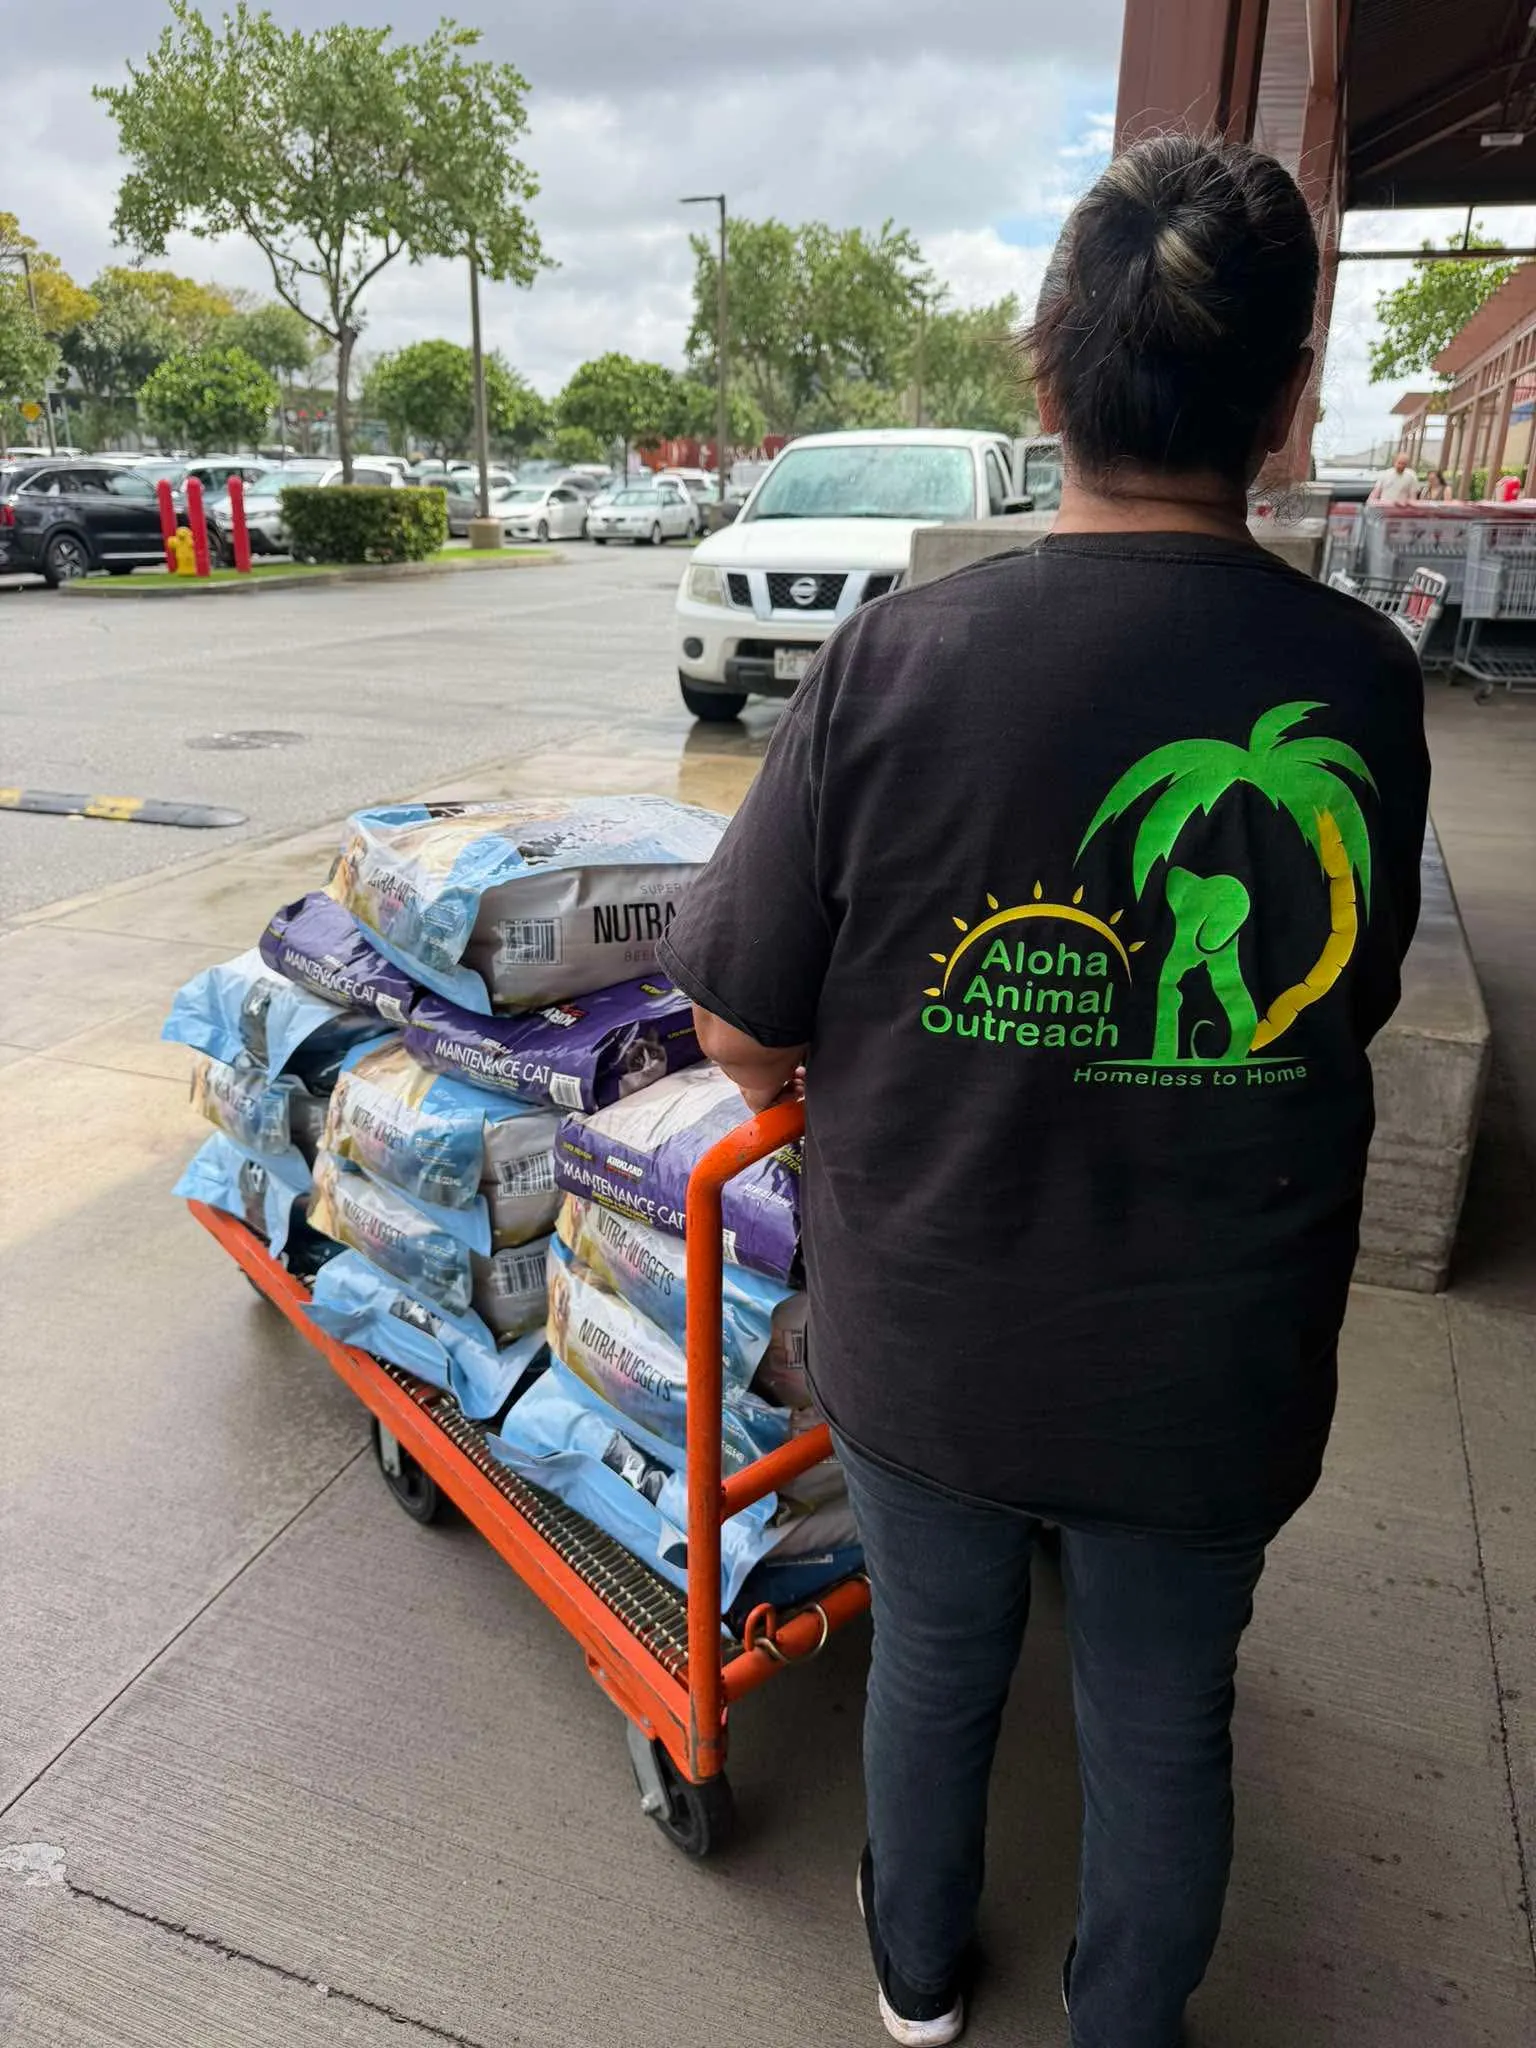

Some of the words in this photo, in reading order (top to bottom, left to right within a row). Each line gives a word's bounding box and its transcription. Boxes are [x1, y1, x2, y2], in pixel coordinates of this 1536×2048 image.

[640, 882, 682, 896] SUPER
[981, 938, 1108, 976] Aloha
[352, 980, 376, 1001] CAT
[963, 975, 1114, 1014] Animal
[921, 1004, 1119, 1047] Outreach
[435, 1039, 522, 1080] MAINTENANCE
[522, 1062, 551, 1085] CAT
[1073, 1067, 1202, 1086] Homeless
[1212, 1070, 1236, 1086] to
[1246, 1065, 1307, 1085] Home
[606, 1154, 644, 1178] KIRKLAND
[563, 1161, 656, 1218] MAINTENANCE
[656, 1206, 686, 1231] CAT
[596, 1206, 675, 1297] NUTRA-NUGGETS
[578, 1317, 673, 1402] NUTRA-NUGGETS
